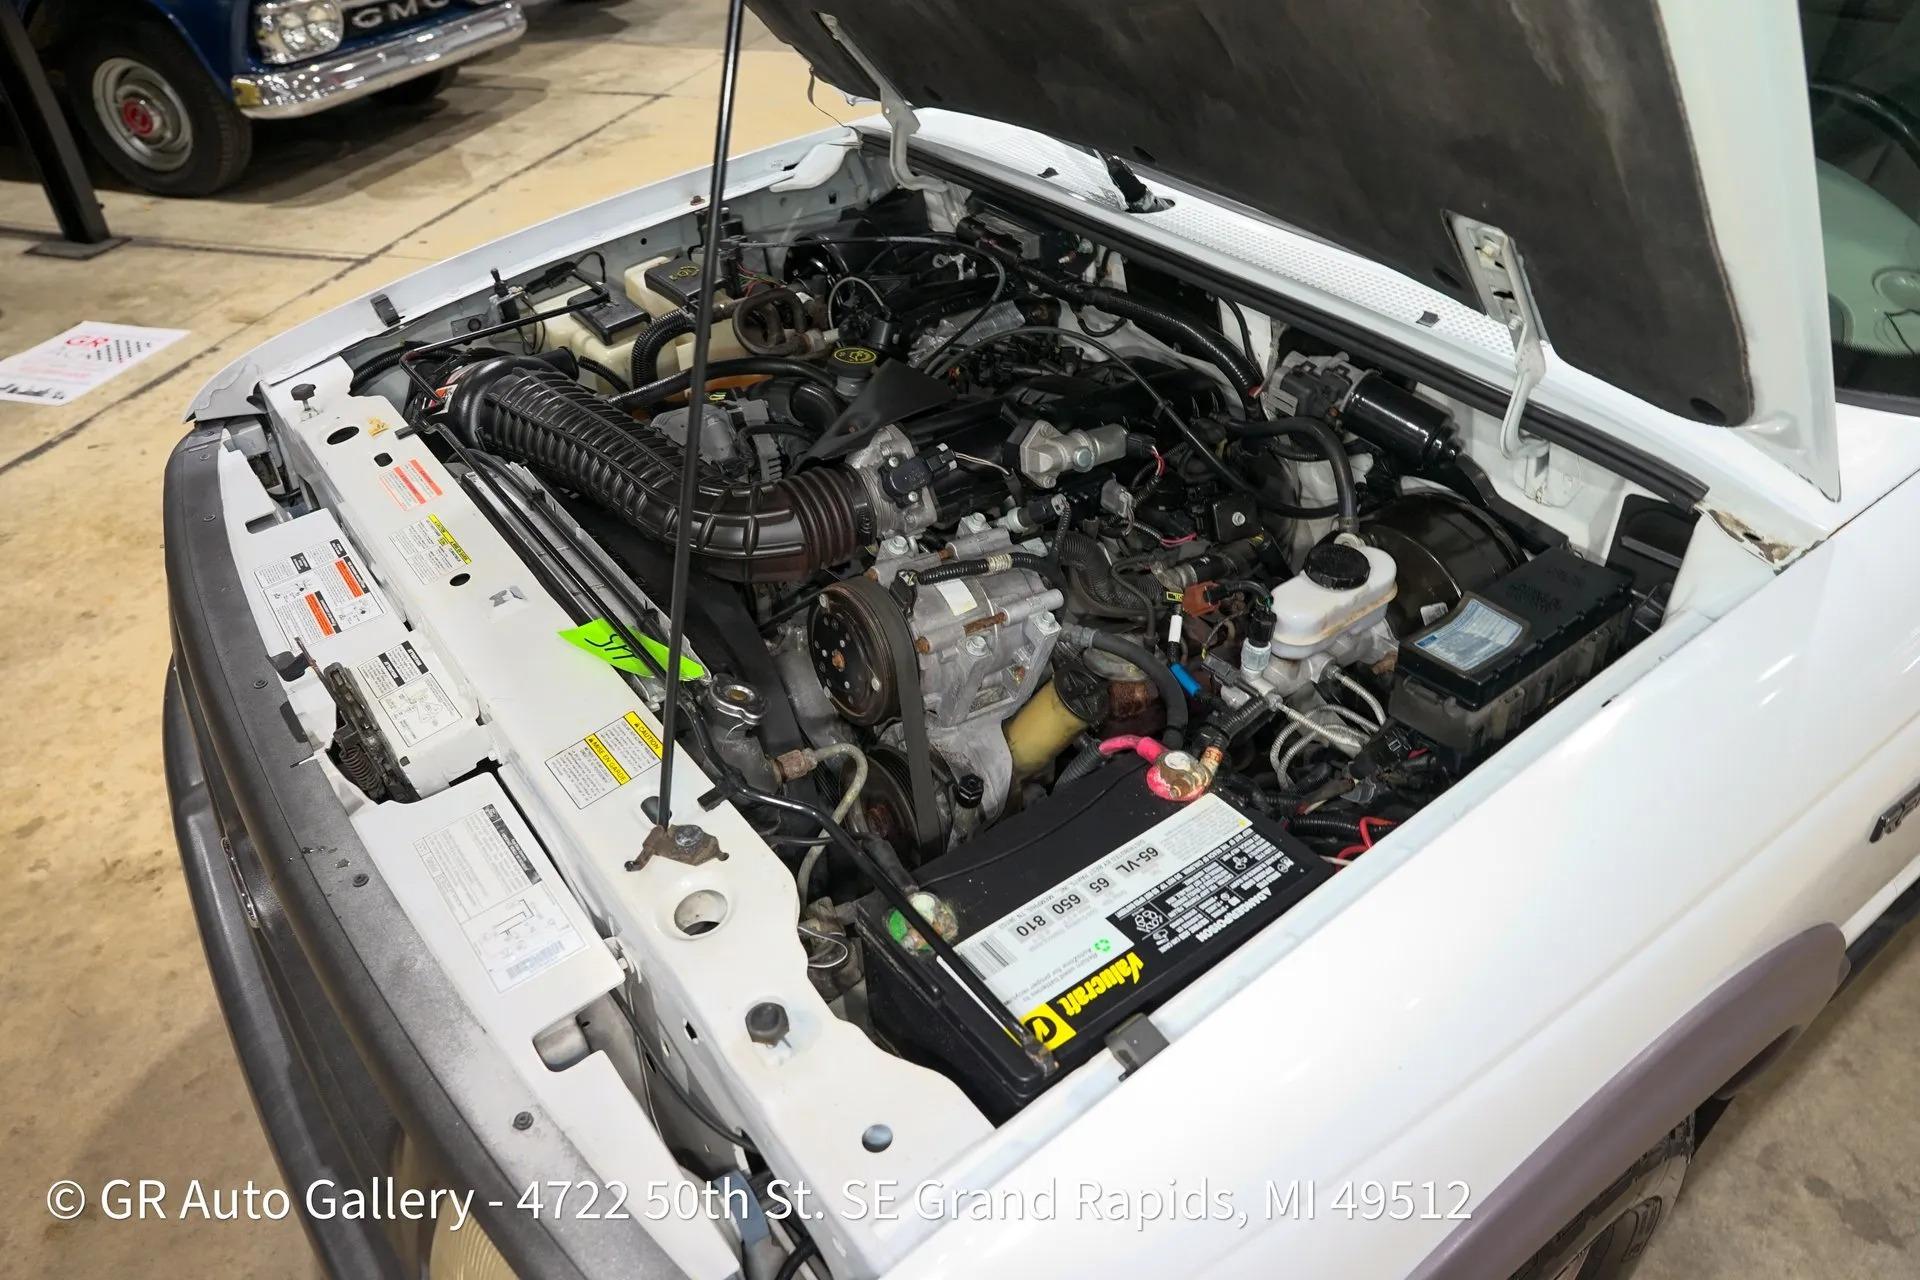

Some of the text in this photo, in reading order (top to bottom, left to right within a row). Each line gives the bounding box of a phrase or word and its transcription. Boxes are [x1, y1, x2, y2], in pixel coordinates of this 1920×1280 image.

[637, 725, 660, 750] CAUTION
[591, 741, 627, 781] MISE EN GARDE
[1115, 847, 1159, 874] 65-VL
[1089, 877, 1110, 893] 65
[1051, 894, 1081, 915] 650
[1016, 917, 1046, 938] 810
[1057, 951, 1144, 1017] Valucraft
